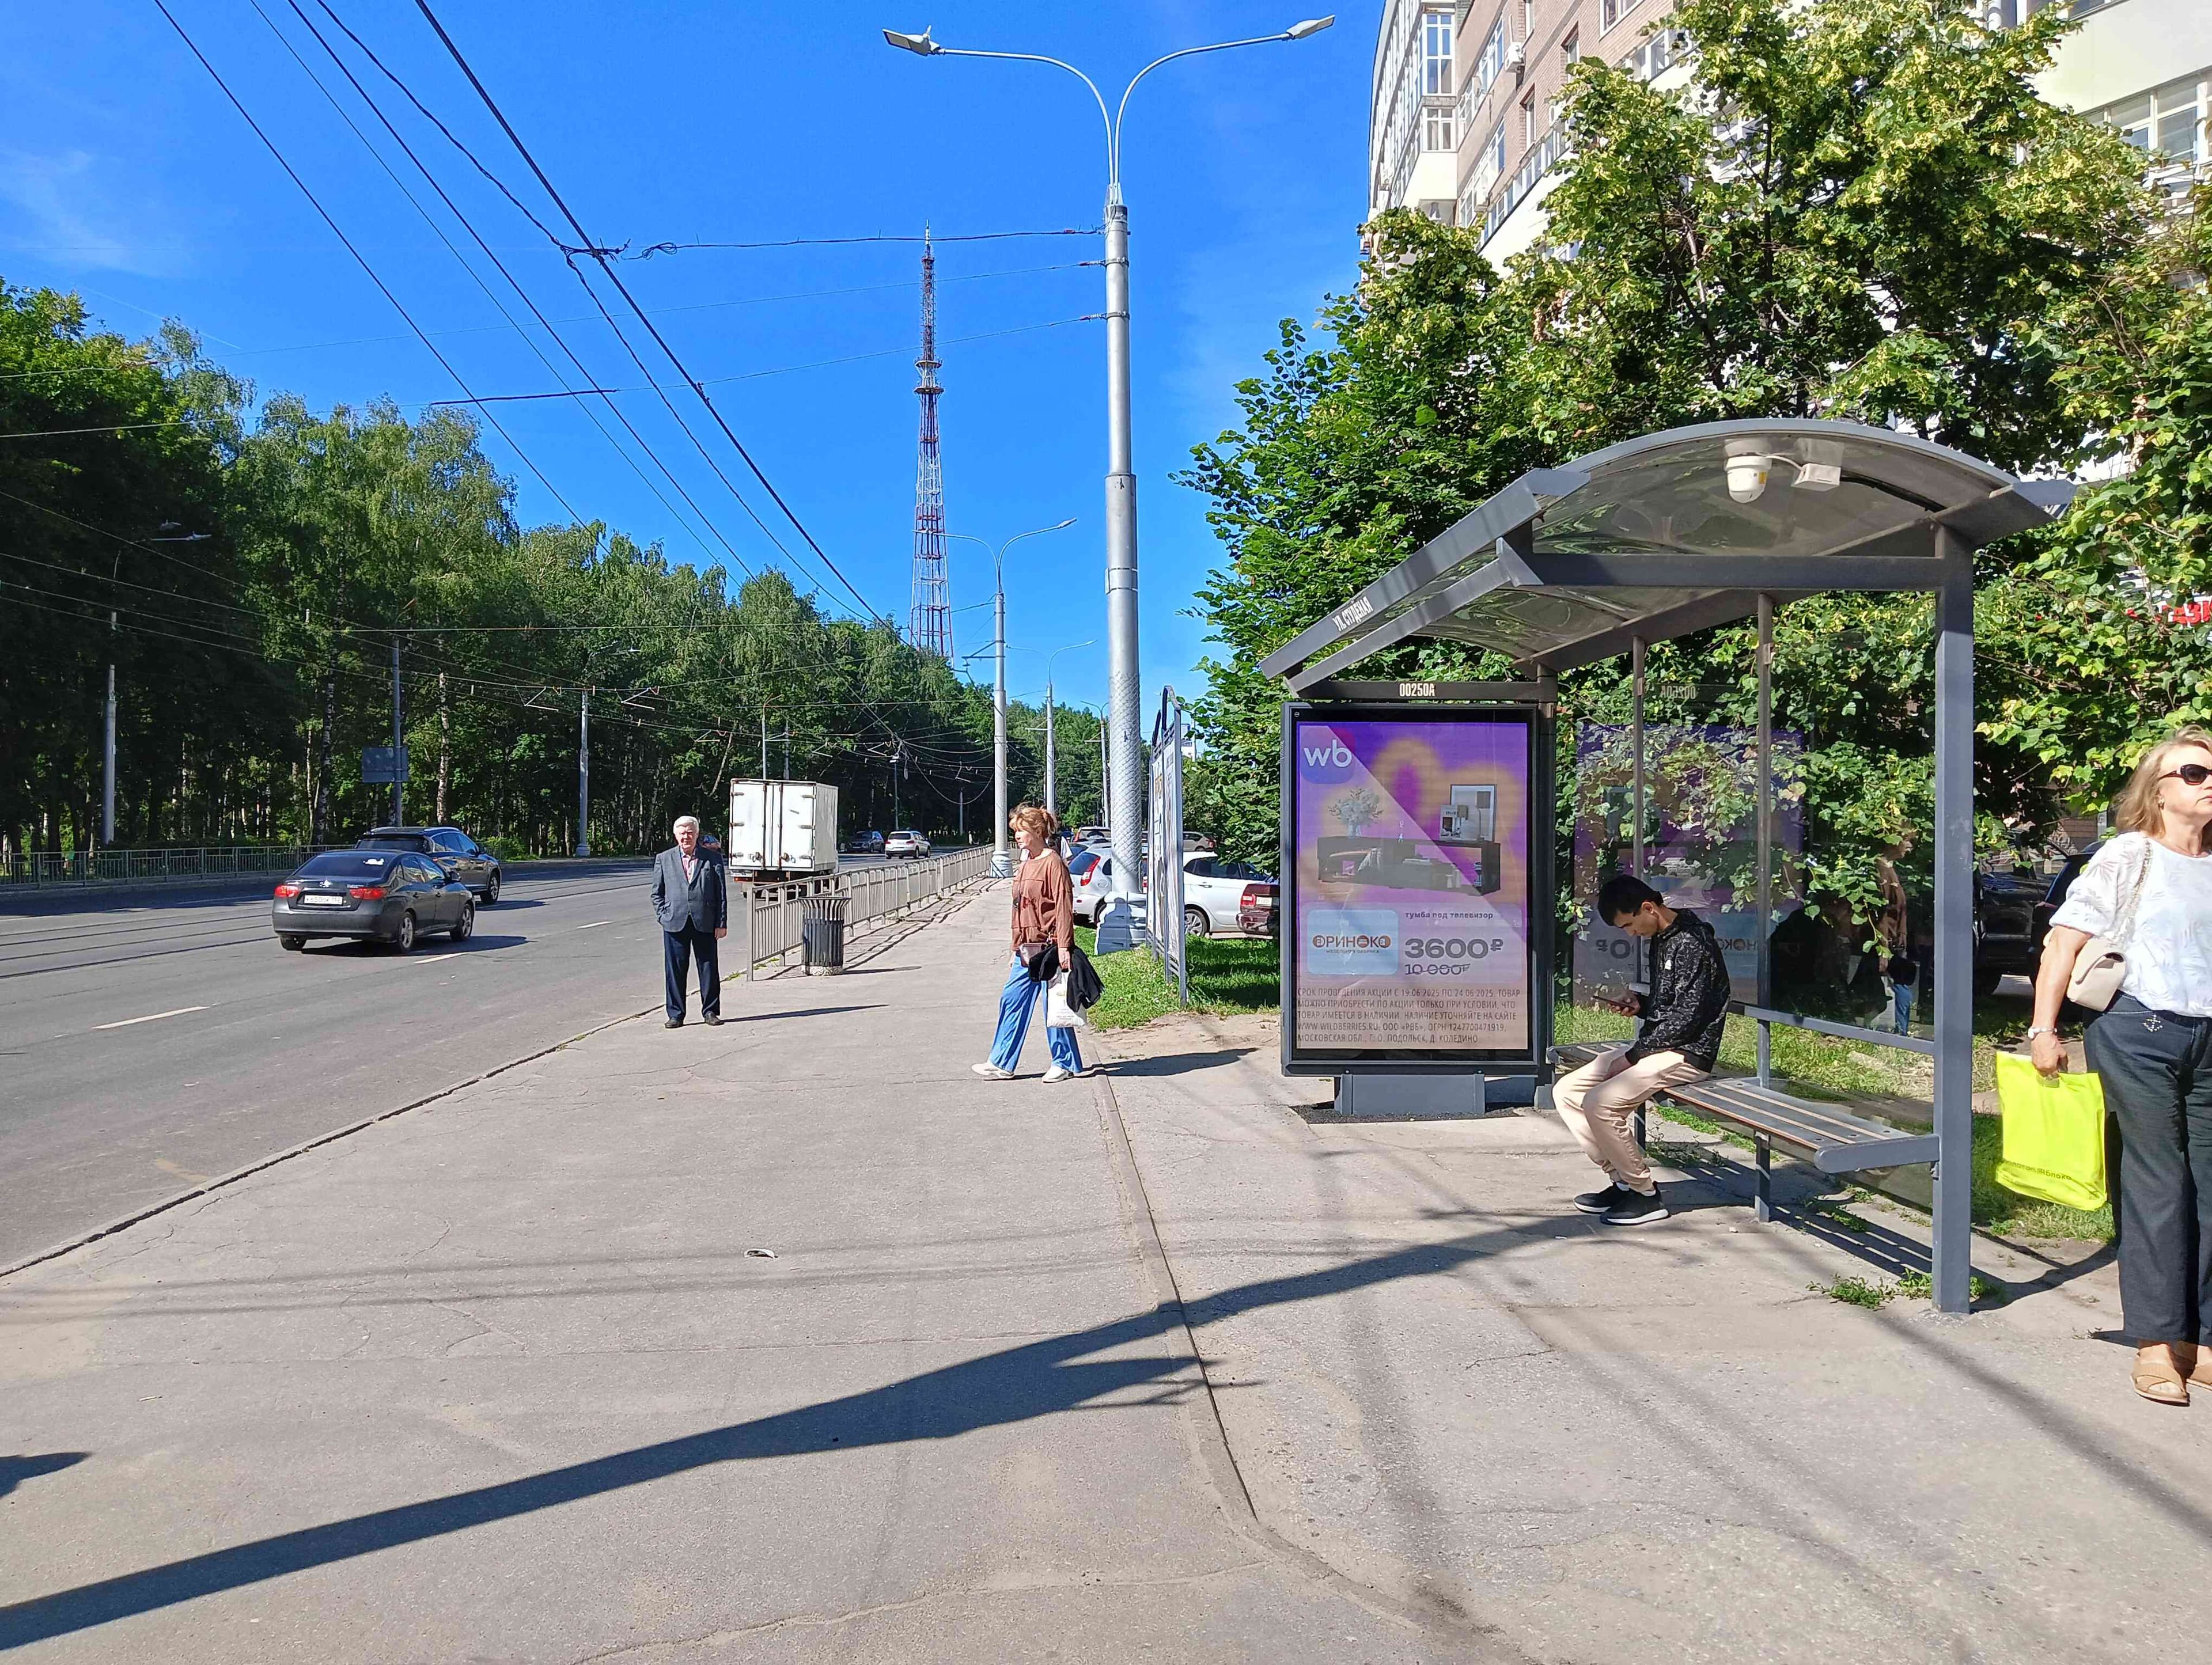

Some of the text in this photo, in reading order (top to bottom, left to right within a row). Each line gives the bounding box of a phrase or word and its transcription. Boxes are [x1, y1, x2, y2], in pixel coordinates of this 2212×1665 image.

[1332, 615, 1347, 631] УЛ.
[1399, 682, 1435, 697] 00250А
[1303, 739, 1353, 767] wb
[1406, 911, 1430, 920] тумба
[1312, 935, 1392, 949] ОРИНОКО
[1368, 988, 1392, 998] АКЦИИ
[1442, 989, 1452, 997] ПО
[1498, 989, 1521, 998] ТОВАР
[1298, 999, 1325, 1007] МОЖНО
[1328, 1000, 1375, 1008] ПРИОБРЕСТИ
[1377, 1000, 1388, 1008] ПО
[1389, 1000, 1414, 1009] АКЦИИ
[1416, 1000, 1444, 1008] ТОЛЬКО
[1446, 1000, 1460, 1008] ПРИ
[1502, 1000, 1515, 1008] ЧТО
[1298, 1011, 1320, 1019] ТОВАР
[1322, 1011, 1354, 1019] ИМЕЕТСЯ
[1404, 1011, 1438, 1019] НАЛИЧИЕ
[1440, 1011, 1481, 1020] УТОЧНЯЙТЕ
[1495, 1011, 1516, 1020] САЙТЕ
[1382, 1023, 1399, 1031] ООО
[1428, 1023, 1446, 1031] ОГРН
[1298, 1034, 1345, 1042] МОСКОВСКАЯ
[1440, 1035, 1478, 1044] КОЛЕДИНО
